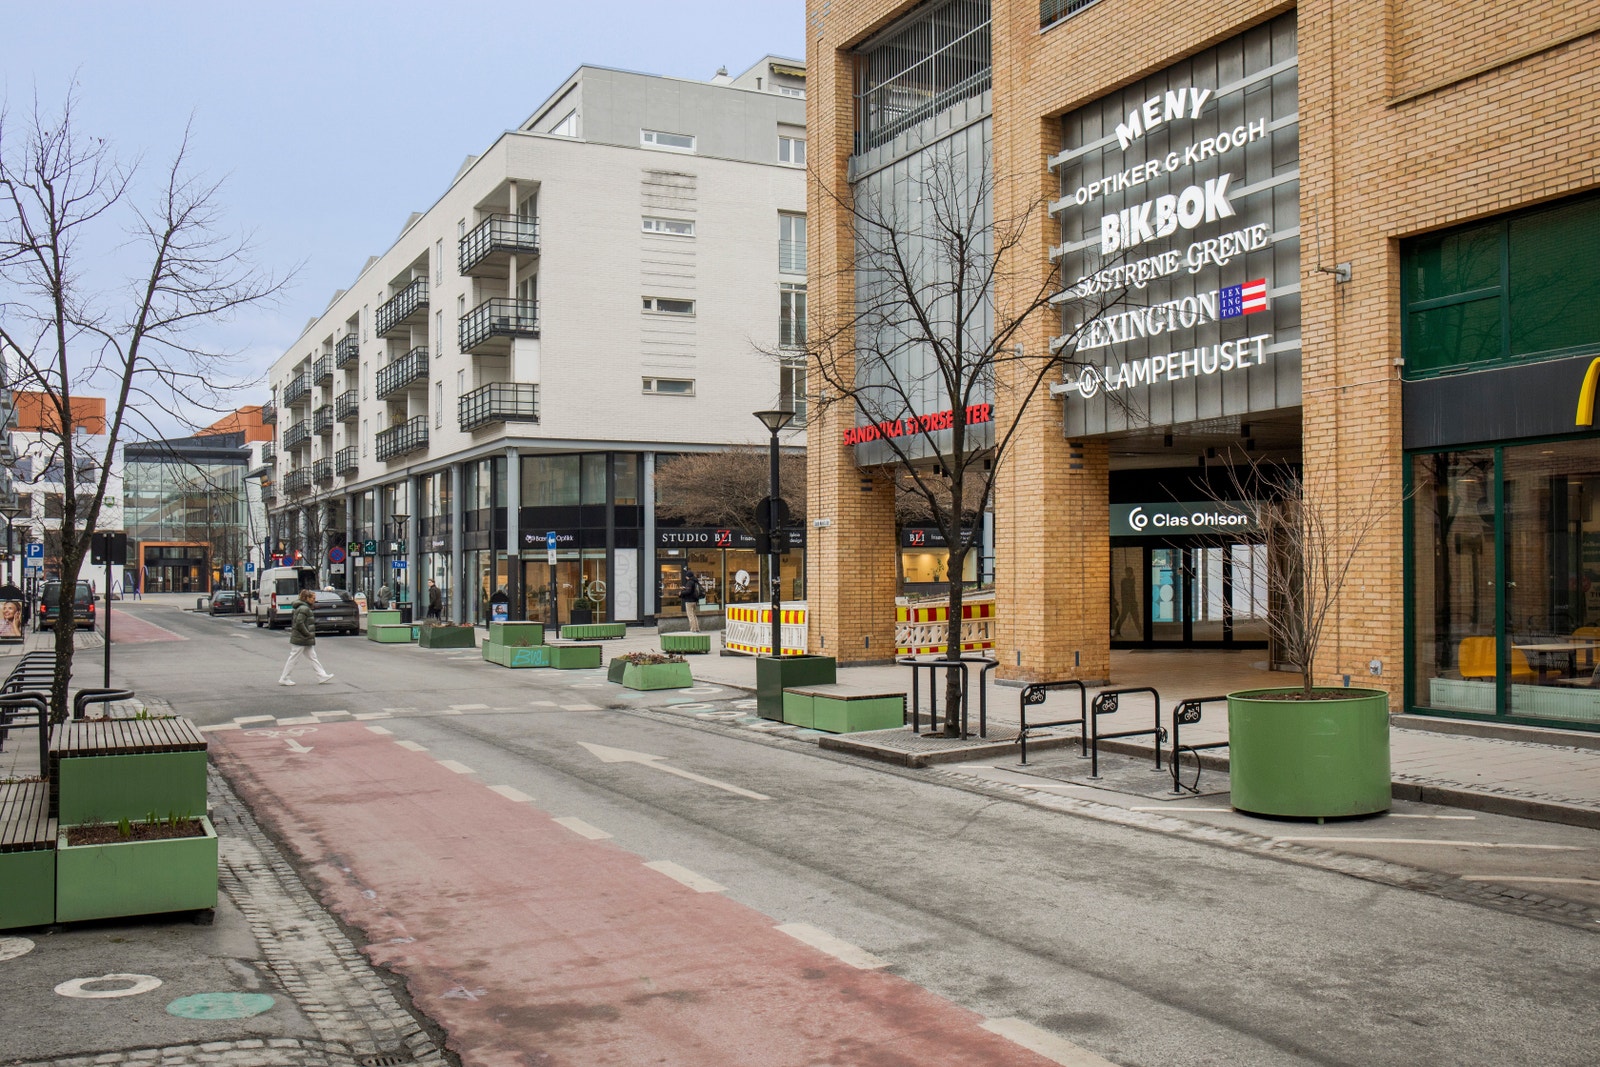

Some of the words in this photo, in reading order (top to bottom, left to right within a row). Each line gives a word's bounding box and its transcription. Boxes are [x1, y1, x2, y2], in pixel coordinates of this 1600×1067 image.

[1115, 87, 1214, 151] MENY
[1075, 159, 1164, 205] OPTIKER
[1184, 117, 1265, 166] KROGH
[1075, 249, 1183, 298] SØSTRENE
[1186, 222, 1272, 274] GRENE
[1221, 286, 1241, 298] LEX
[1222, 298, 1241, 306] ING
[1075, 290, 1220, 352] LEXINGTON
[1221, 306, 1242, 317] TON
[1104, 333, 1274, 393] LAMPEHUSET
[843, 417, 904, 446] SANDVIKA
[905, 402, 992, 435] STORSETER
[1152, 513, 1190, 527] Clas
[1191, 512, 1248, 526] Ohlson
[31, 545, 40, 556] P
[662, 533, 708, 542] STUDIO
